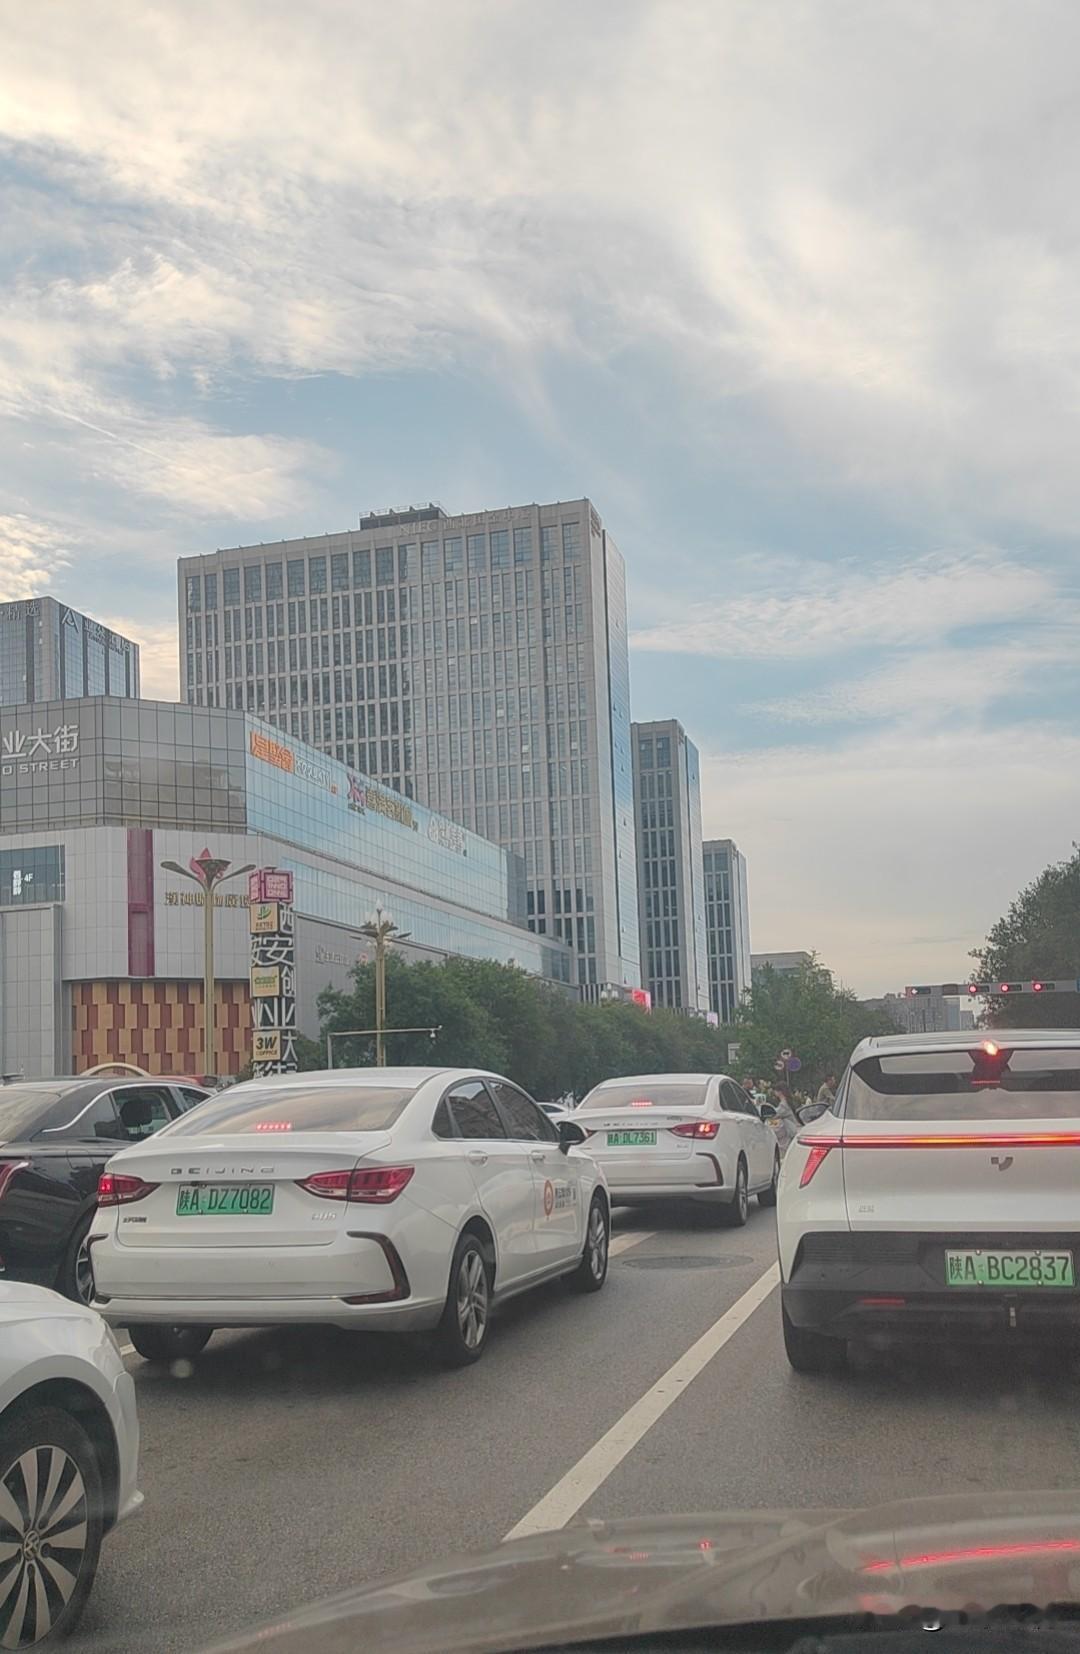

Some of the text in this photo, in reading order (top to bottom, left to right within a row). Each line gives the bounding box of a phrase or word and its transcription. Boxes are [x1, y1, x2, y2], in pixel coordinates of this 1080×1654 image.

[1, 725, 79, 759] 业大街
[20, 759, 78, 773] STREET
[256, 1037, 278, 1049] 3W
[207, 1187, 272, 1211] DZ7082
[987, 1256, 1069, 1281] BC2837
